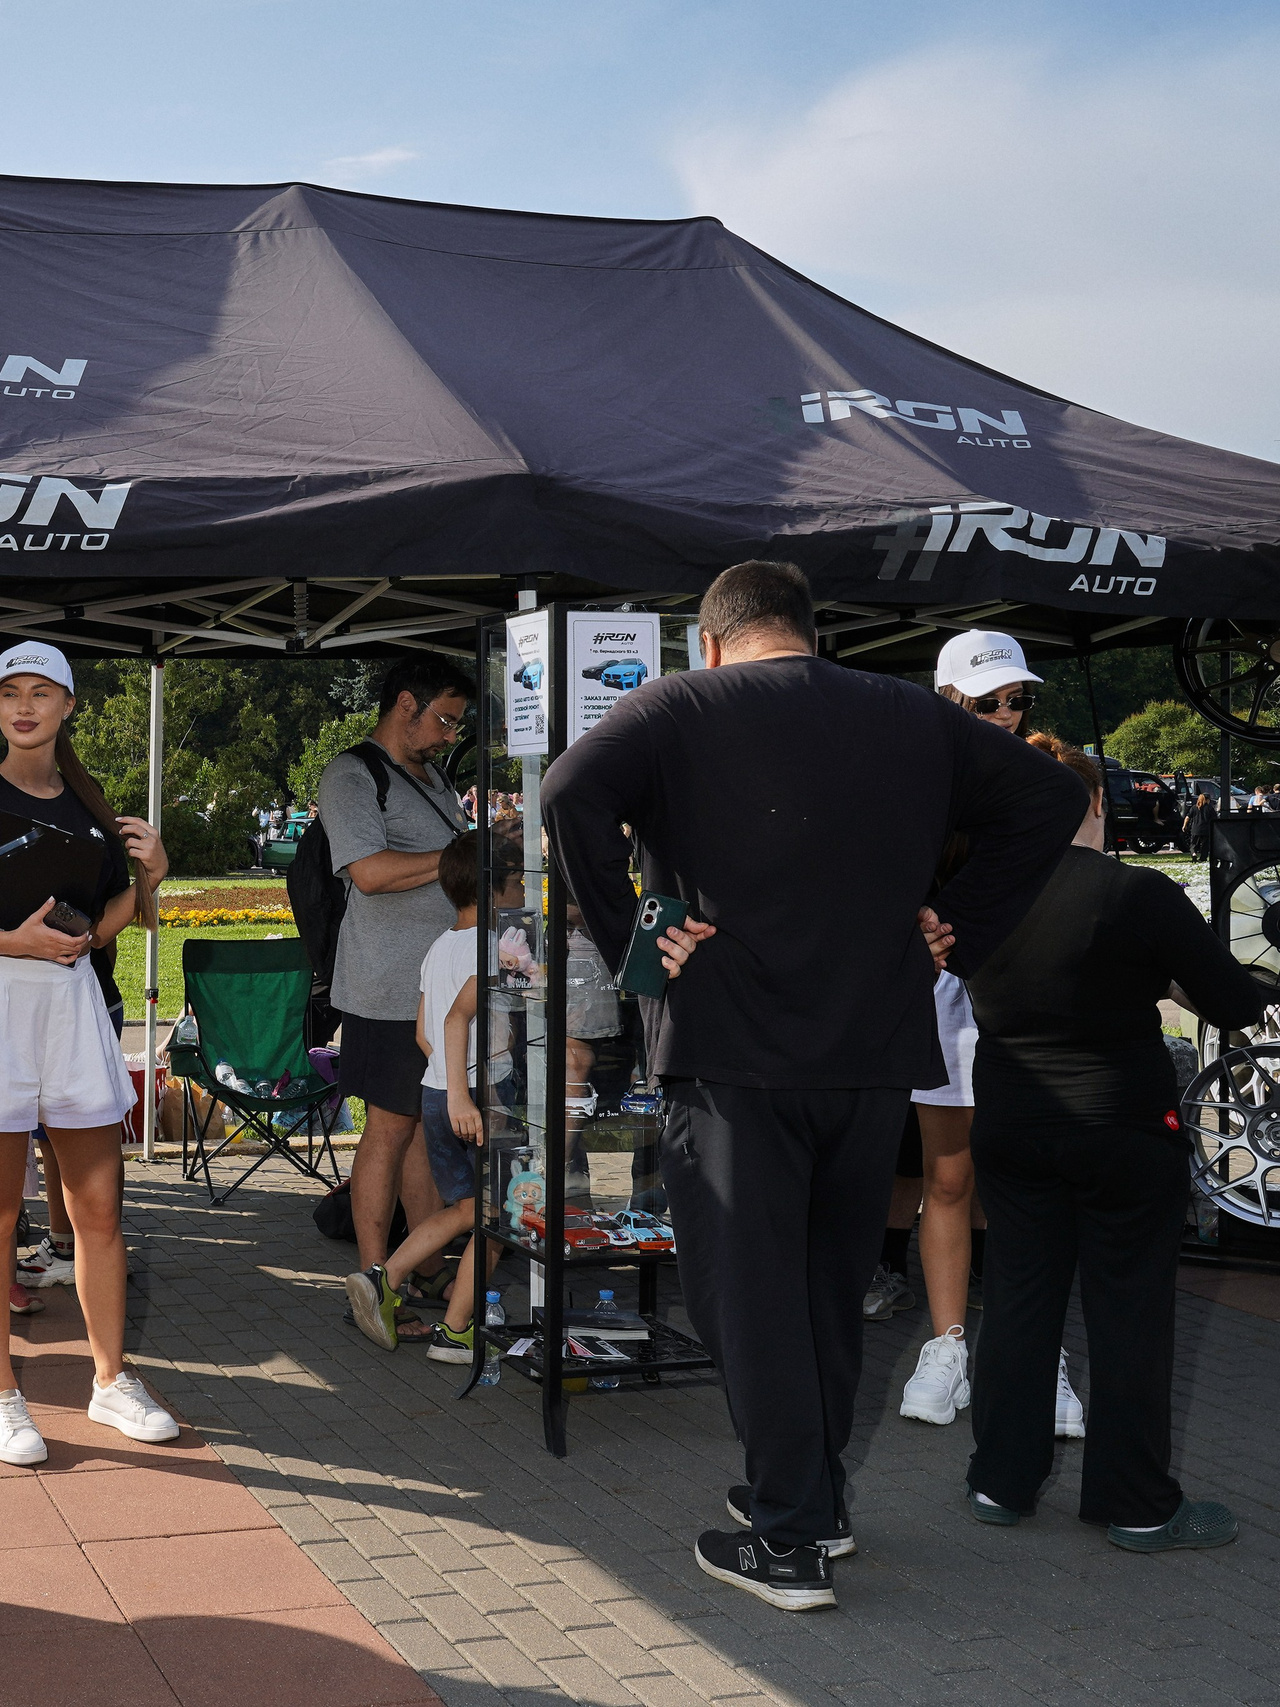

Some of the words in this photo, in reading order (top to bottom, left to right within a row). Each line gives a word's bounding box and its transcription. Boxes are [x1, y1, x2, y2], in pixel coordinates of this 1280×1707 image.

[956, 436, 1031, 449] AUTO
[1068, 574, 1157, 596] AUTO
[738, 1545, 758, 1571] N
